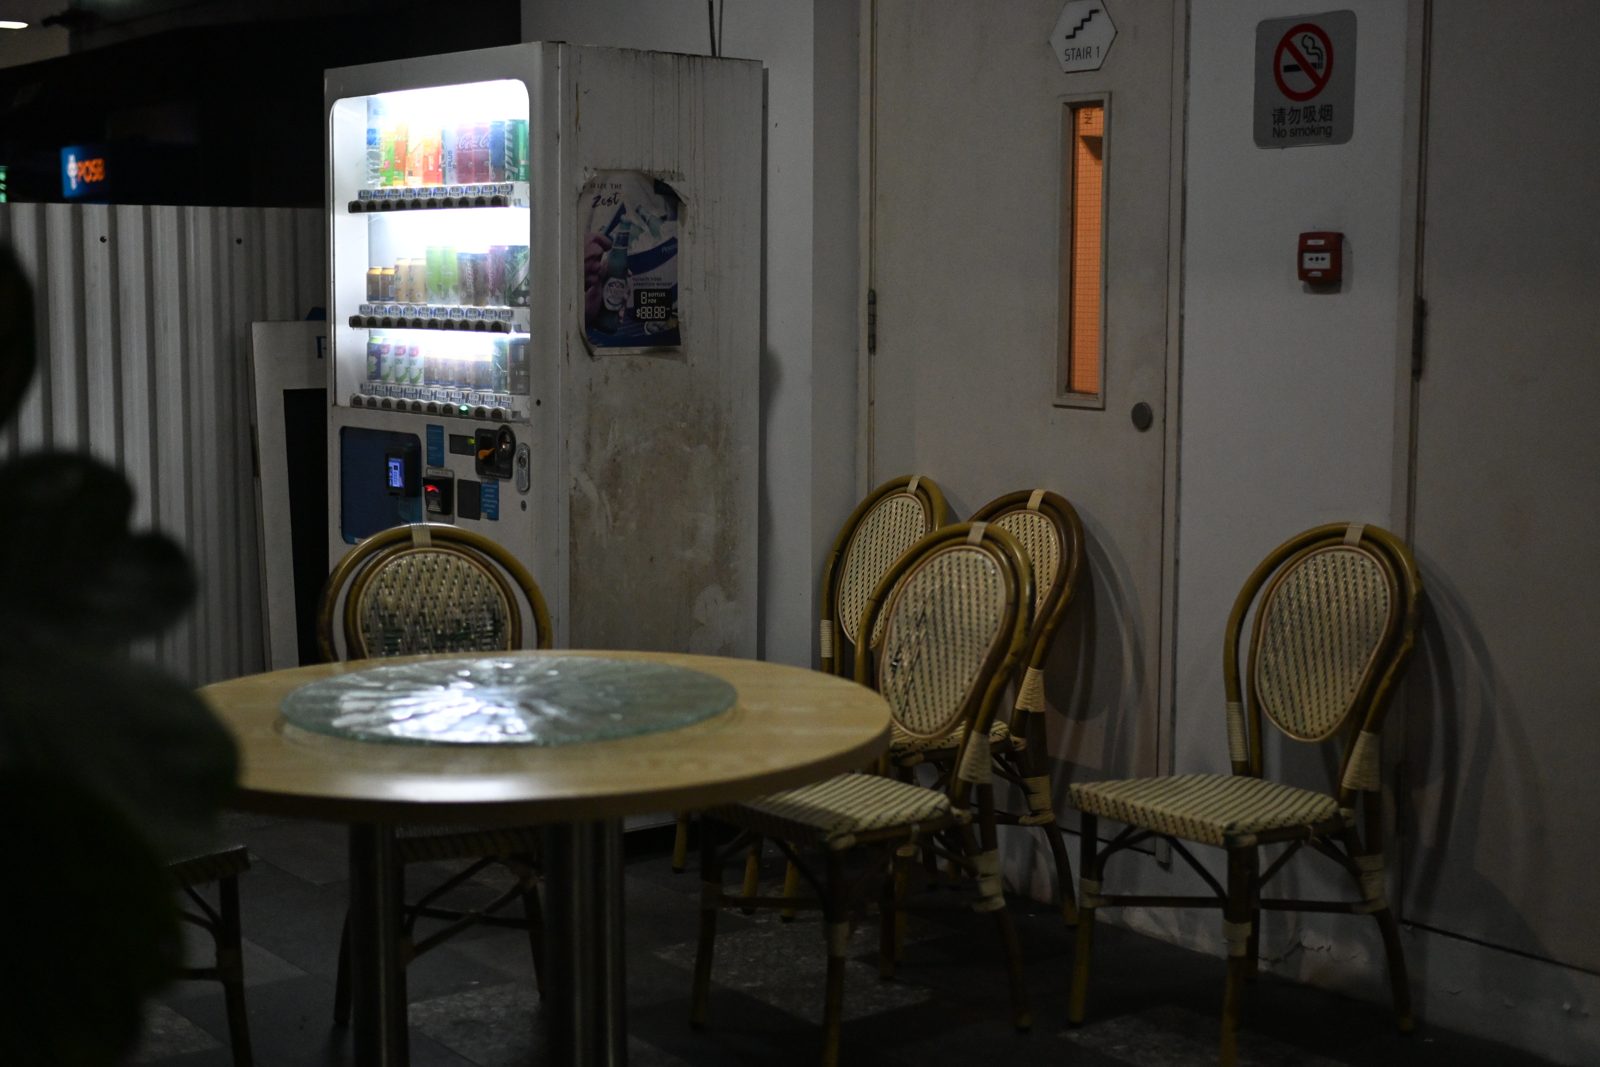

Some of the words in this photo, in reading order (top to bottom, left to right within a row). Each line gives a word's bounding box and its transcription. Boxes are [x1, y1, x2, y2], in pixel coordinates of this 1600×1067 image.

[1064, 46, 1092, 62] STAIR
[1095, 46, 1100, 58] 1
[1272, 104, 1333, 126] 请勿吸烟
[1272, 127, 1287, 138] No
[1289, 125, 1333, 138] smoking
